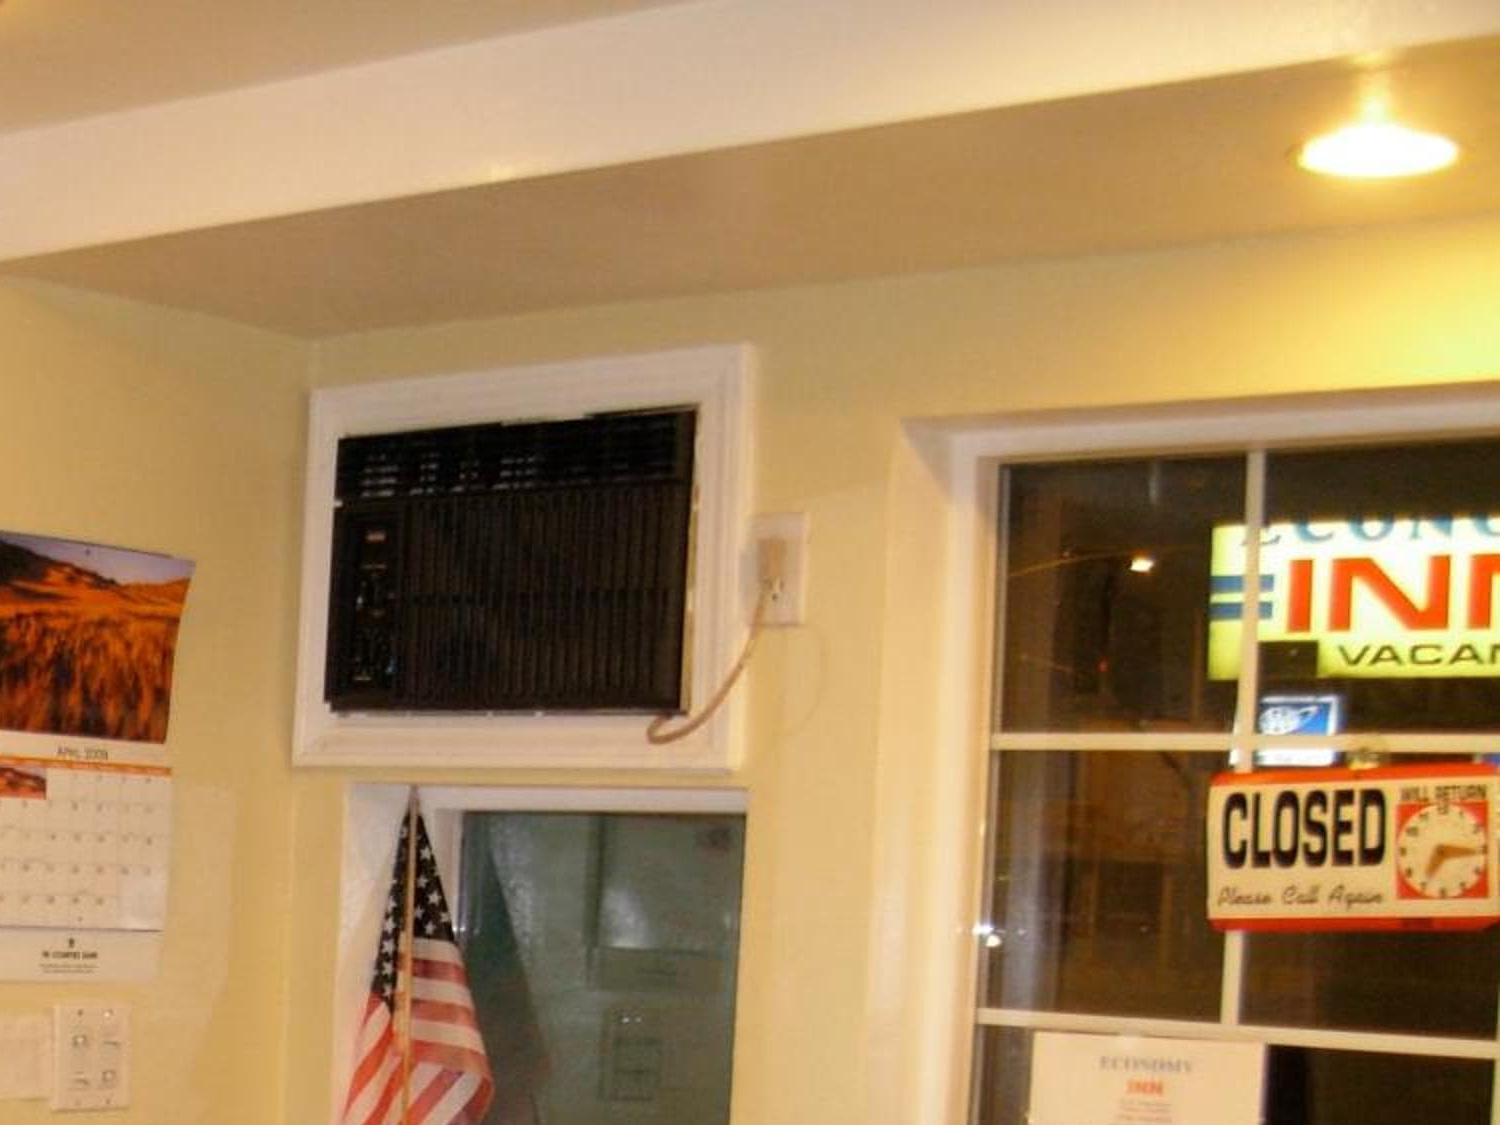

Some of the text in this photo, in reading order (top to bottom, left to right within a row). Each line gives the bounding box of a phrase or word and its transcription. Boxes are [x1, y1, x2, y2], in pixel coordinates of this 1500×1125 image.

[1287, 554, 1500, 632] IN
[1435, 785, 1487, 801] RETURN
[1222, 788, 1387, 869] CLOSED
[1218, 884, 1384, 909] Please Call Again
[1100, 1056, 1193, 1073] ECONOMY
